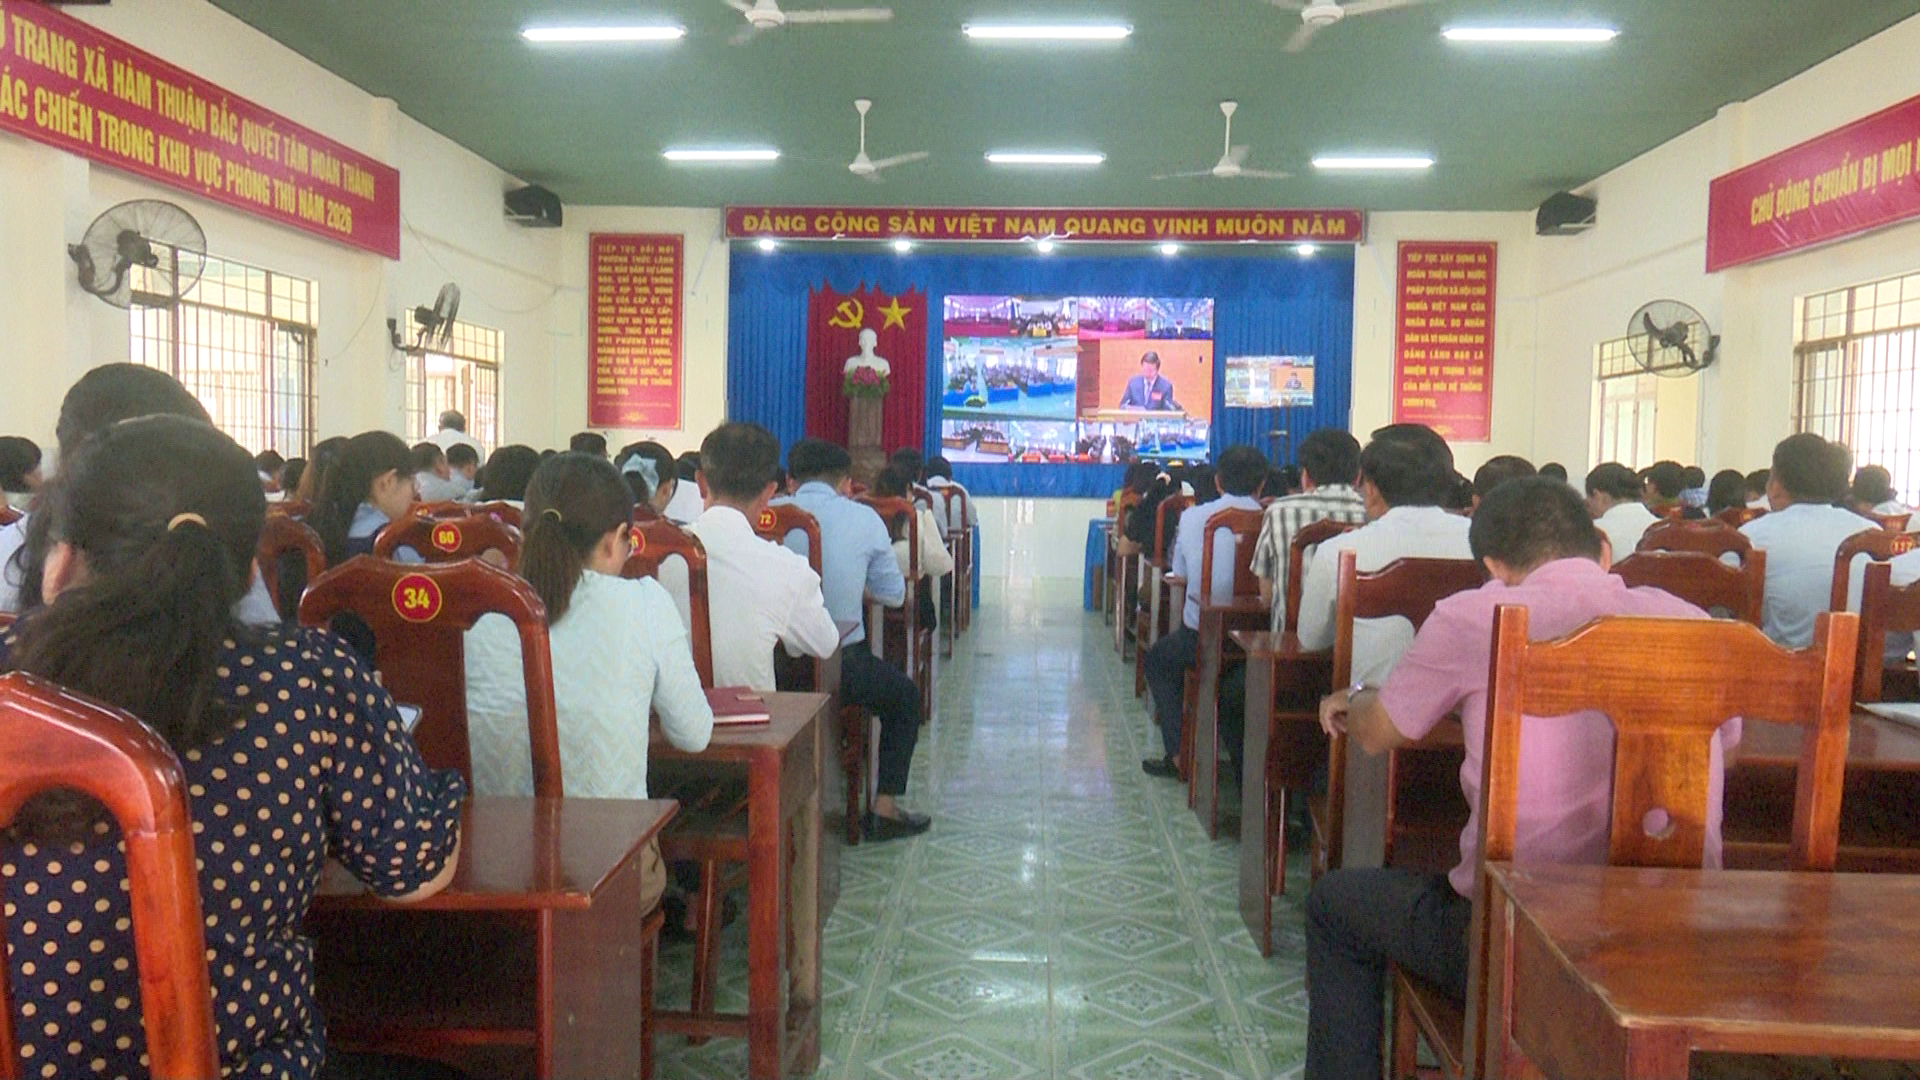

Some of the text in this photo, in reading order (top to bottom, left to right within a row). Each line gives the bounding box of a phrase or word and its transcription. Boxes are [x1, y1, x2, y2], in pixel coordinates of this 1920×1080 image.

[12, 14, 78, 80] TRANG
[84, 46, 108, 92] XÃ
[113, 58, 152, 110] HÀM
[156, 79, 207, 136] THUẬN
[210, 97, 238, 145] BẮC
[242, 118, 281, 162] QUYẾT
[284, 133, 308, 174] TÂM
[34, 86, 93, 144] CHIẾN
[98, 110, 155, 166] TRONG
[159, 134, 190, 178] KHU
[194, 147, 222, 194] VỰC
[226, 160, 270, 207] PHÒNG
[273, 175, 296, 214] THỦ
[299, 186, 325, 225] NĂM
[327, 199, 352, 234] 2026
[1751, 182, 1775, 226] CHỦ
[1776, 178, 1810, 222] ĐỘNG
[1862, 153, 1878, 195] BỊ
[1881, 141, 1912, 186] MỌI
[743, 209, 1346, 238] ĐẢNG CỘNG SẢN VIỆT NAM QUANG VINH MUÔN NĂM
[404, 587, 430, 609] 34
